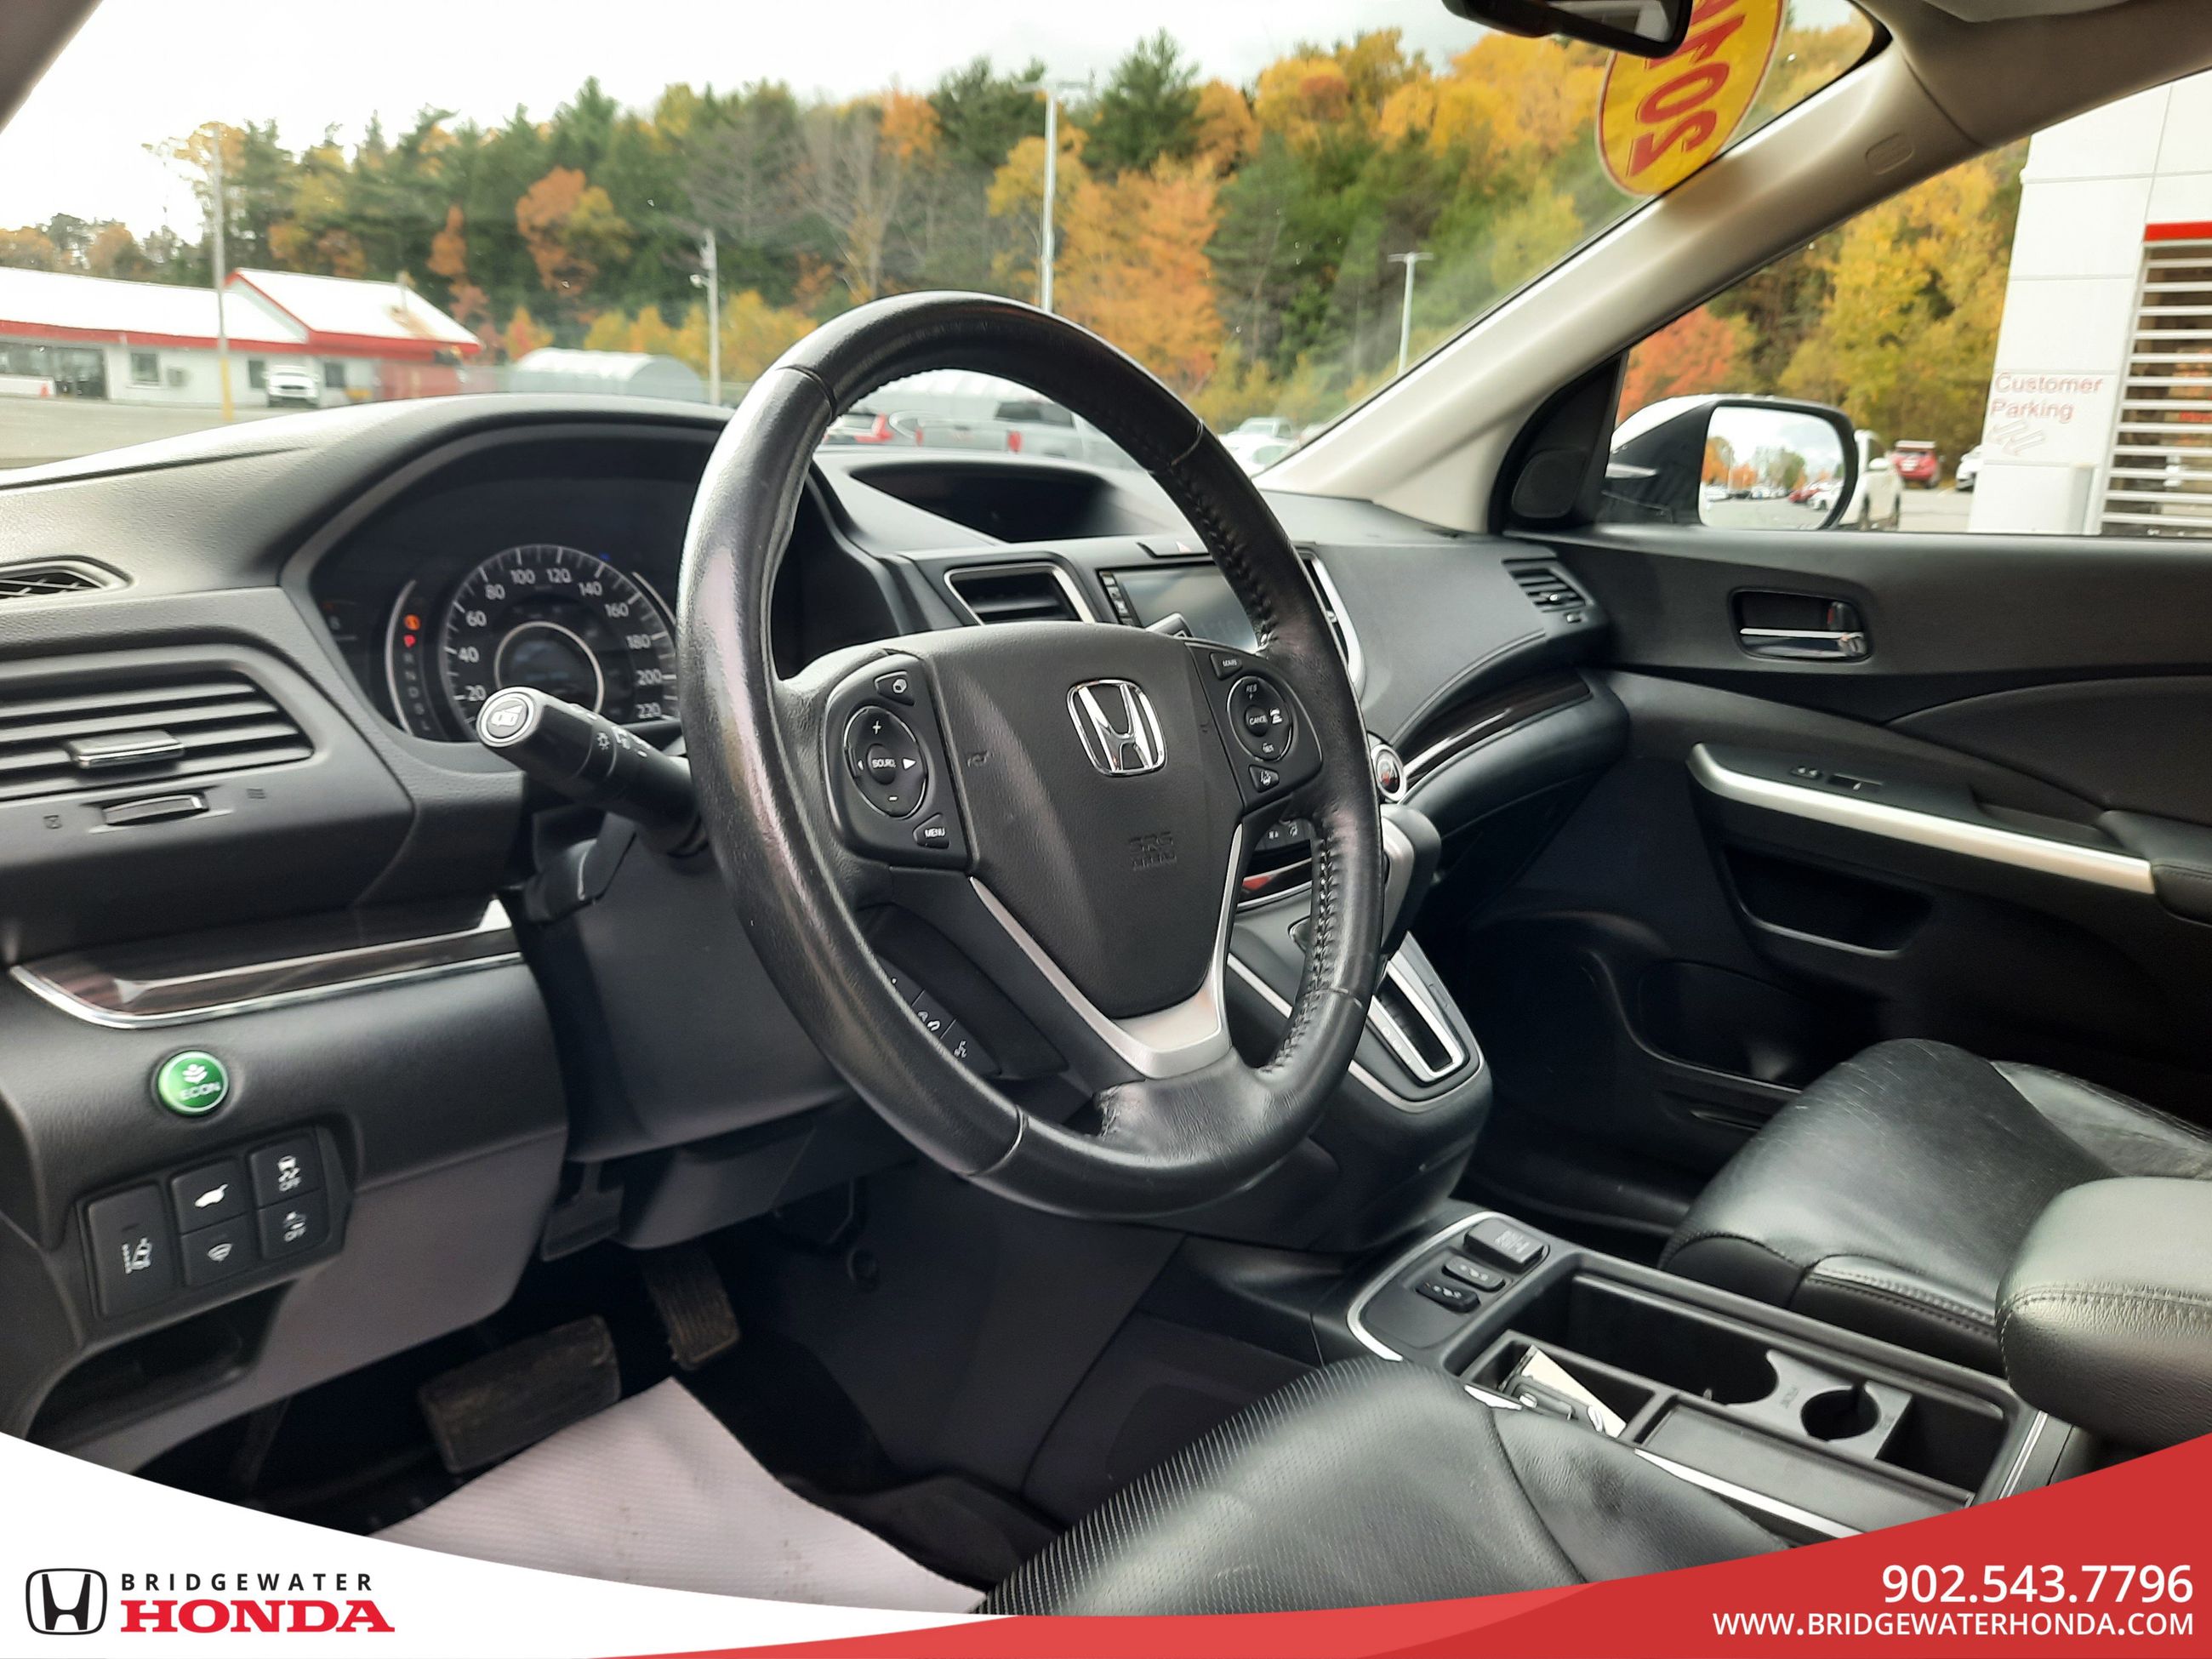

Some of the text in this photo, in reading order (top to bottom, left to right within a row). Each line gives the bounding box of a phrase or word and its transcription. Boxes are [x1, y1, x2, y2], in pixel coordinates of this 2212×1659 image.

[1994, 372, 2103, 394] Customer
[1991, 397, 2074, 424] Parking
[511, 568, 535, 584] 100
[546, 567, 572, 584] 120
[485, 584, 505, 600] 80
[579, 581, 602, 596] 140
[605, 601, 629, 618] 160
[465, 610, 487, 627] 60
[626, 633, 651, 649] 180
[458, 646, 480, 663] 40
[636, 668, 663, 686] 200
[465, 684, 487, 702] 20
[635, 702, 661, 719] 220
[924, 827, 945, 838] MENU
[180, 1081, 221, 1102] ECON
